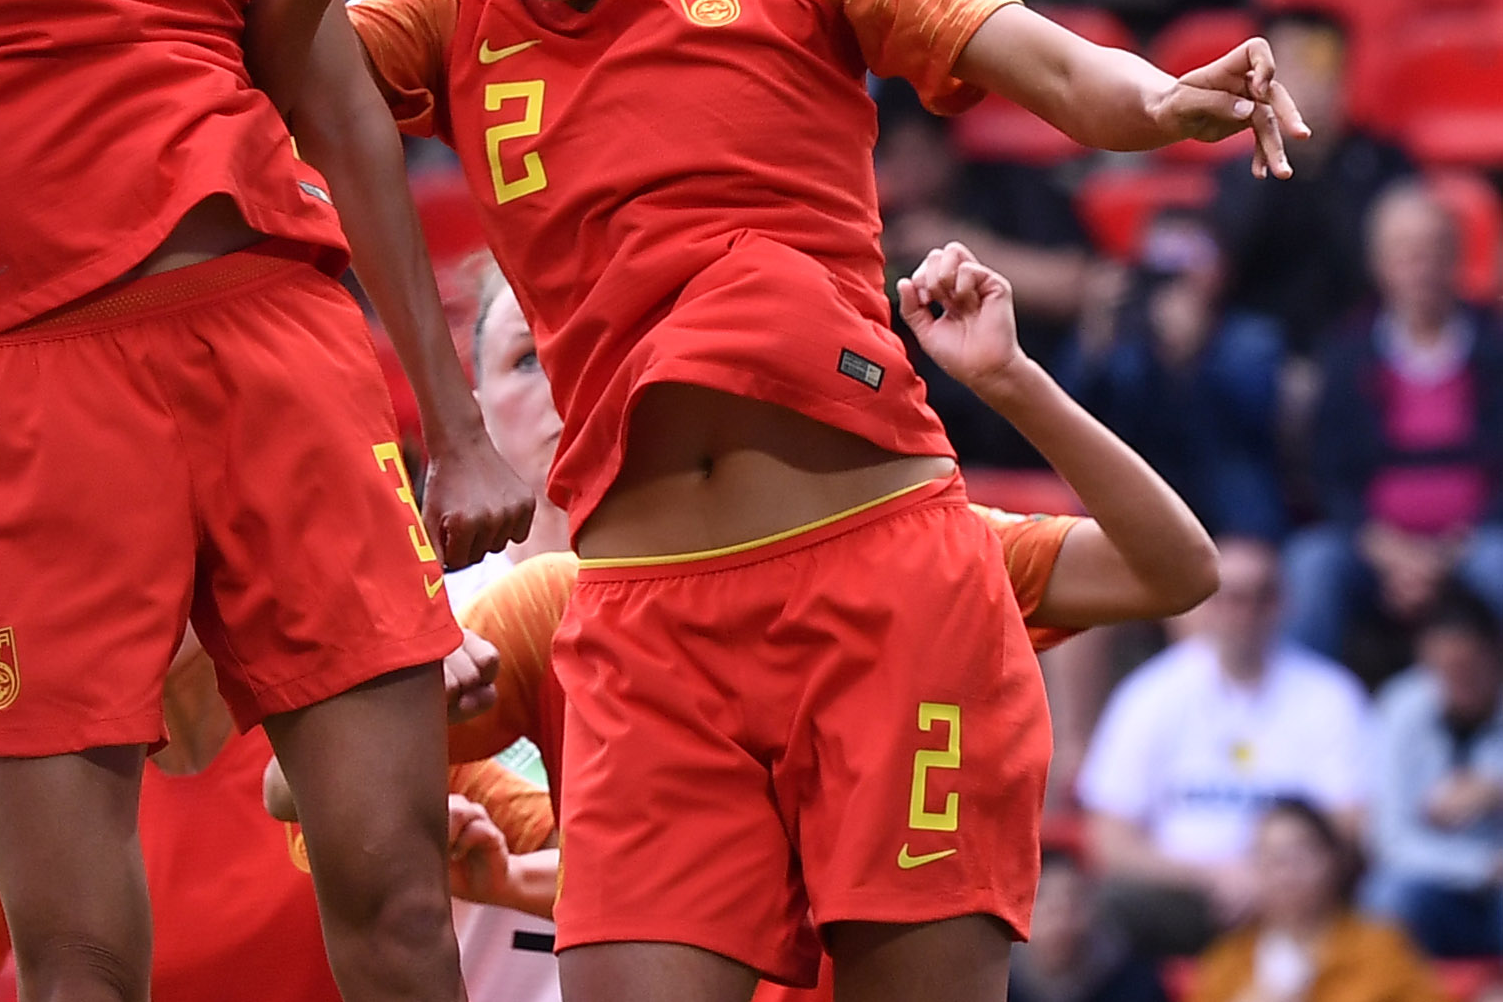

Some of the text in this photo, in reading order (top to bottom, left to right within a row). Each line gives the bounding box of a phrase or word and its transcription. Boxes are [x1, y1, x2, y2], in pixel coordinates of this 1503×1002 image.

[484, 79, 547, 205] 2
[372, 441, 436, 562] 3
[908, 702, 961, 832] 2
